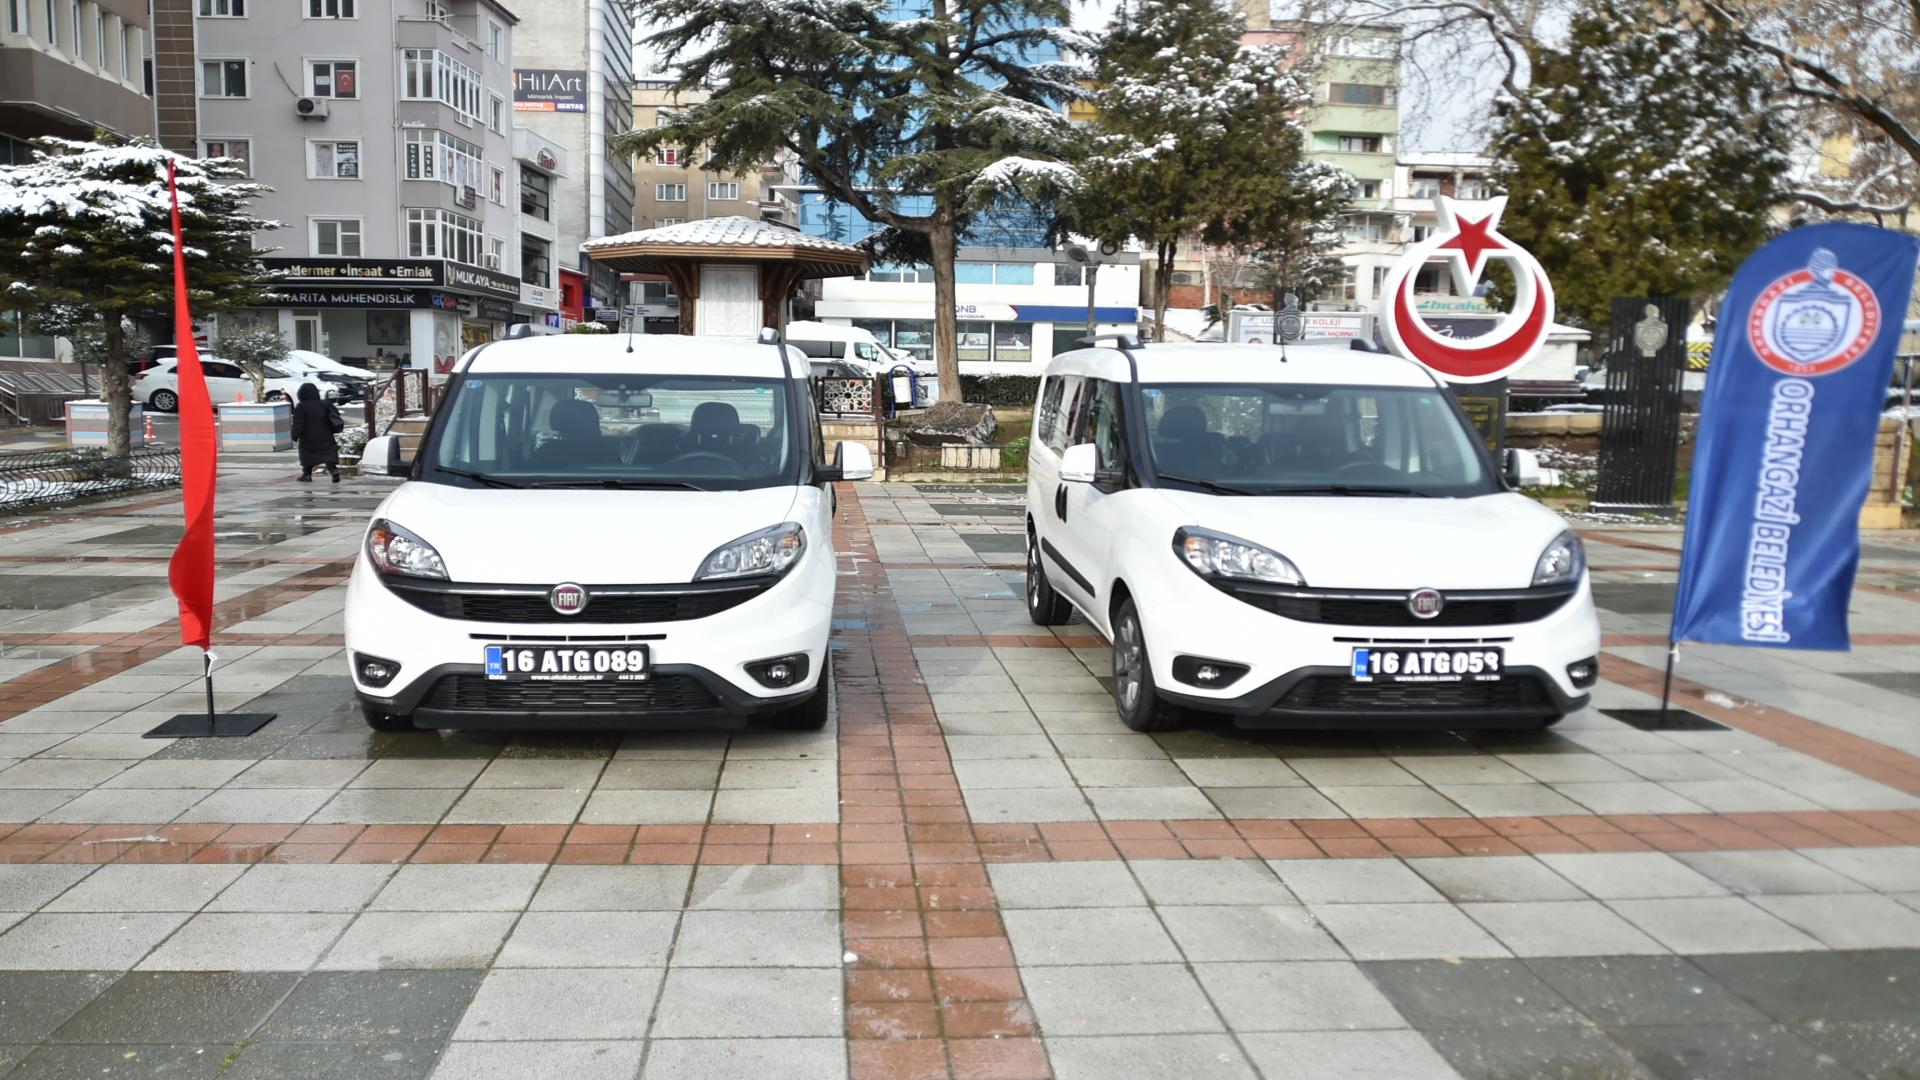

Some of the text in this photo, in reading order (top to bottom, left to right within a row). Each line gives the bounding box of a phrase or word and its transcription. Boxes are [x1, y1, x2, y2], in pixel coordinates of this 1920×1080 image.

[518, 73, 582, 91] HilArt
[291, 265, 336, 276] Mermer
[397, 266, 432, 277] Emlak
[456, 271, 490, 288] MUKAYA
[954, 305, 977, 314] QNB
[1755, 378, 1815, 525] ORHANGAZİ
[1741, 522, 1793, 643] BELEDİYESİ
[558, 592, 579, 606] FIAT
[1417, 597, 1436, 611] FIAT
[502, 650, 534, 672] 16
[541, 650, 590, 673] ATG
[594, 650, 643, 672] 089
[1369, 652, 1399, 674] 16
[1404, 652, 1450, 674] ATG
